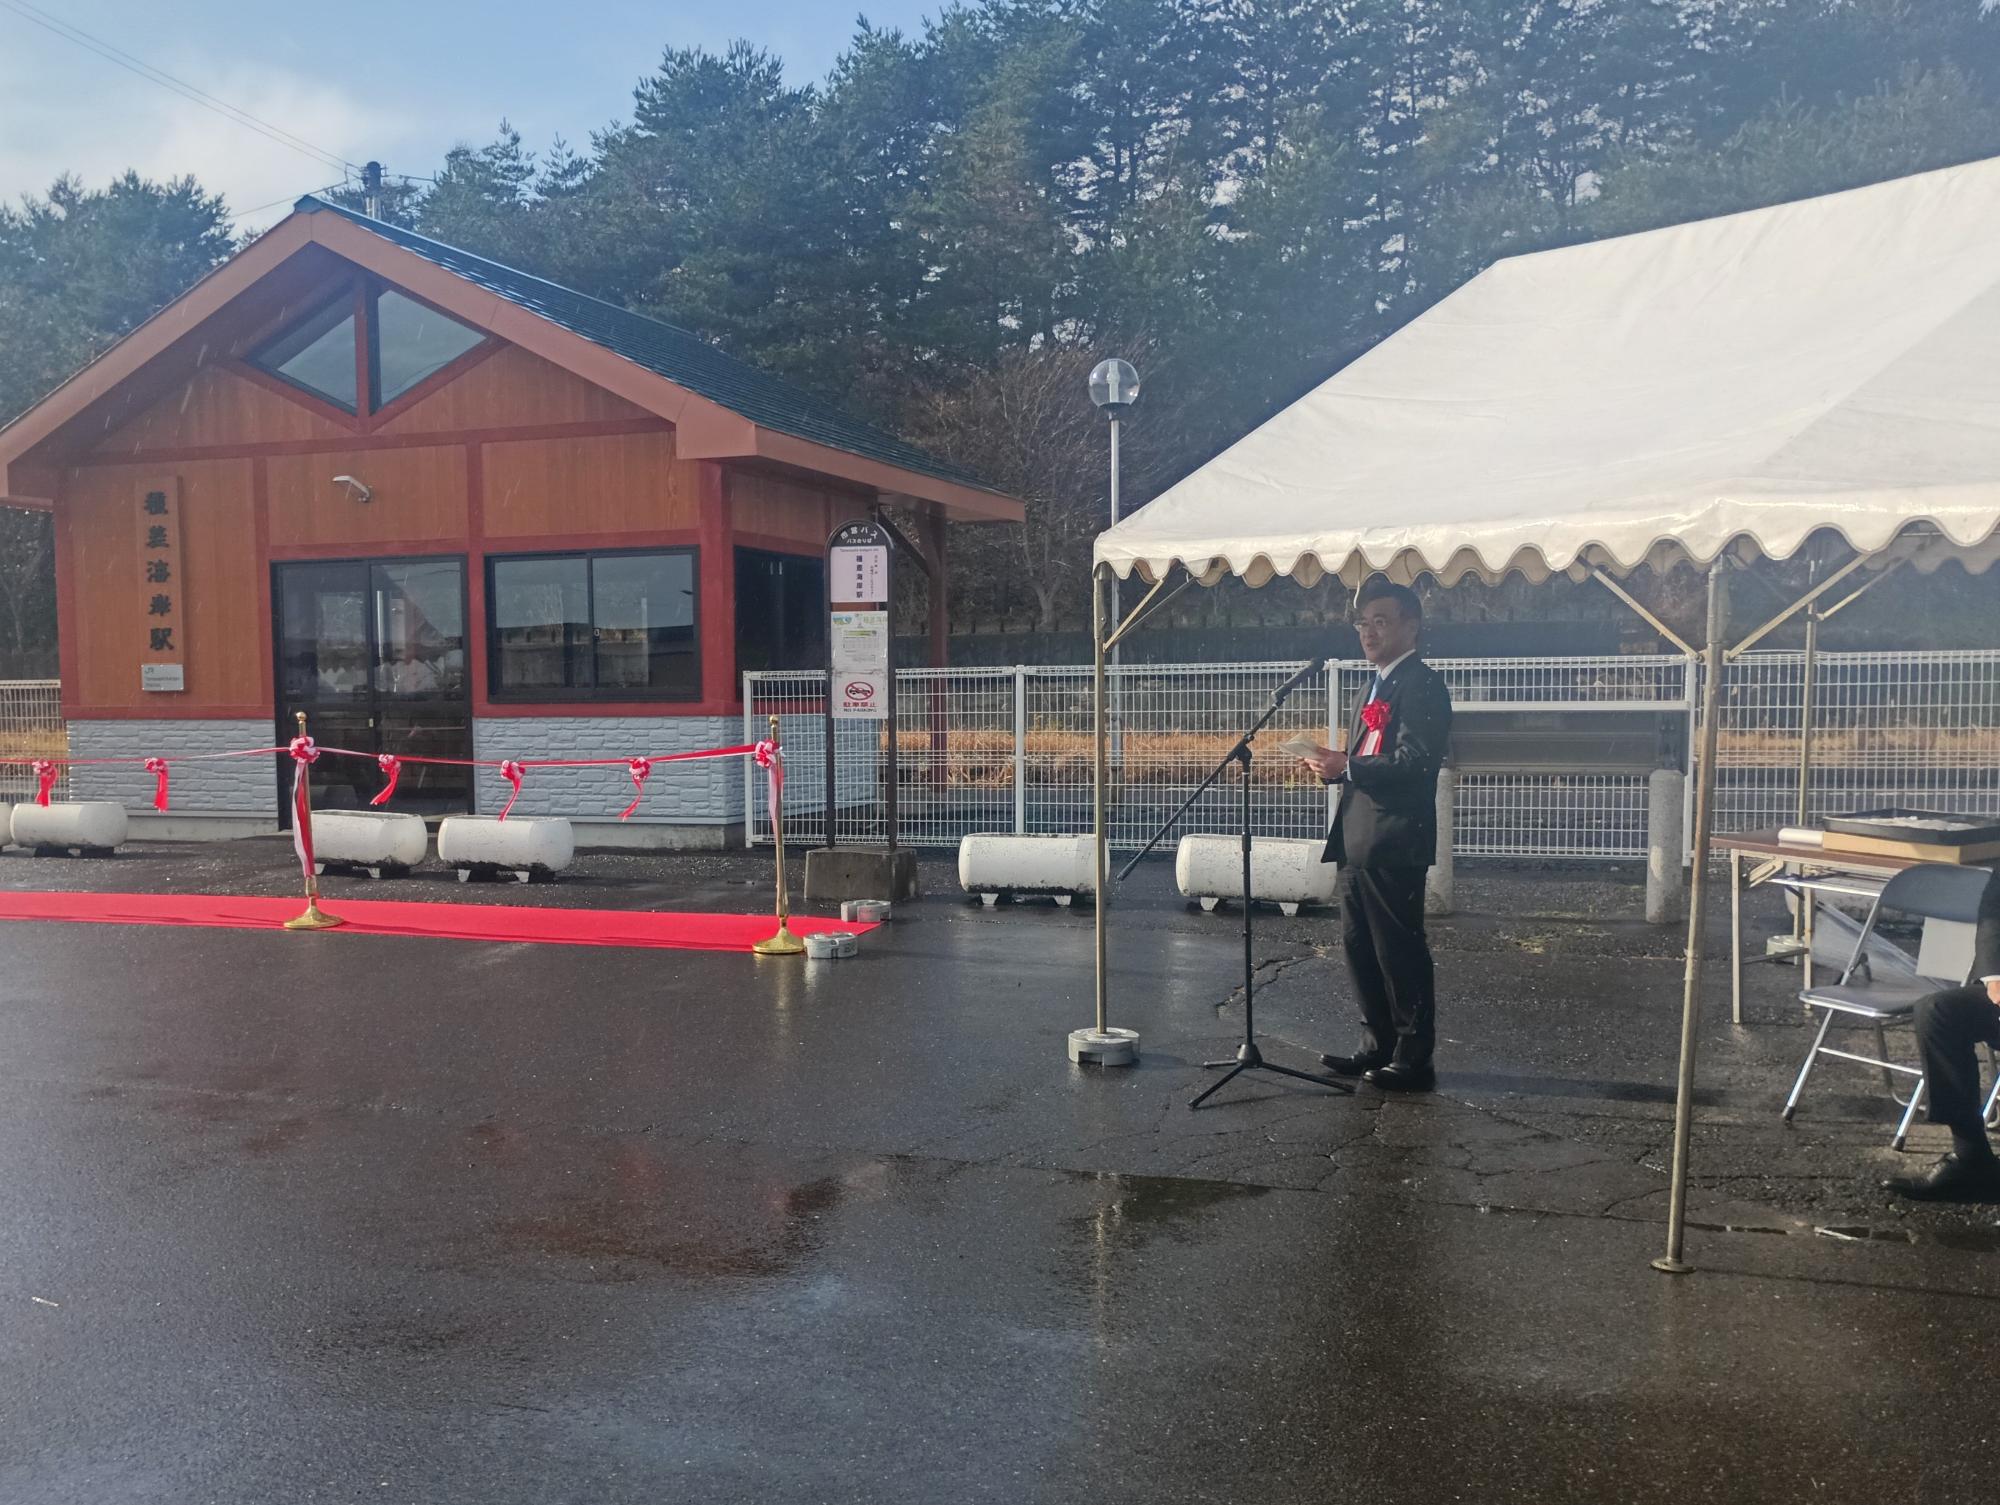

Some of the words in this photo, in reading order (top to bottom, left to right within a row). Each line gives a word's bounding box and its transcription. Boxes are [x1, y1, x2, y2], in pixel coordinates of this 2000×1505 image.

[144, 491, 174, 651] 種差海岸駅
